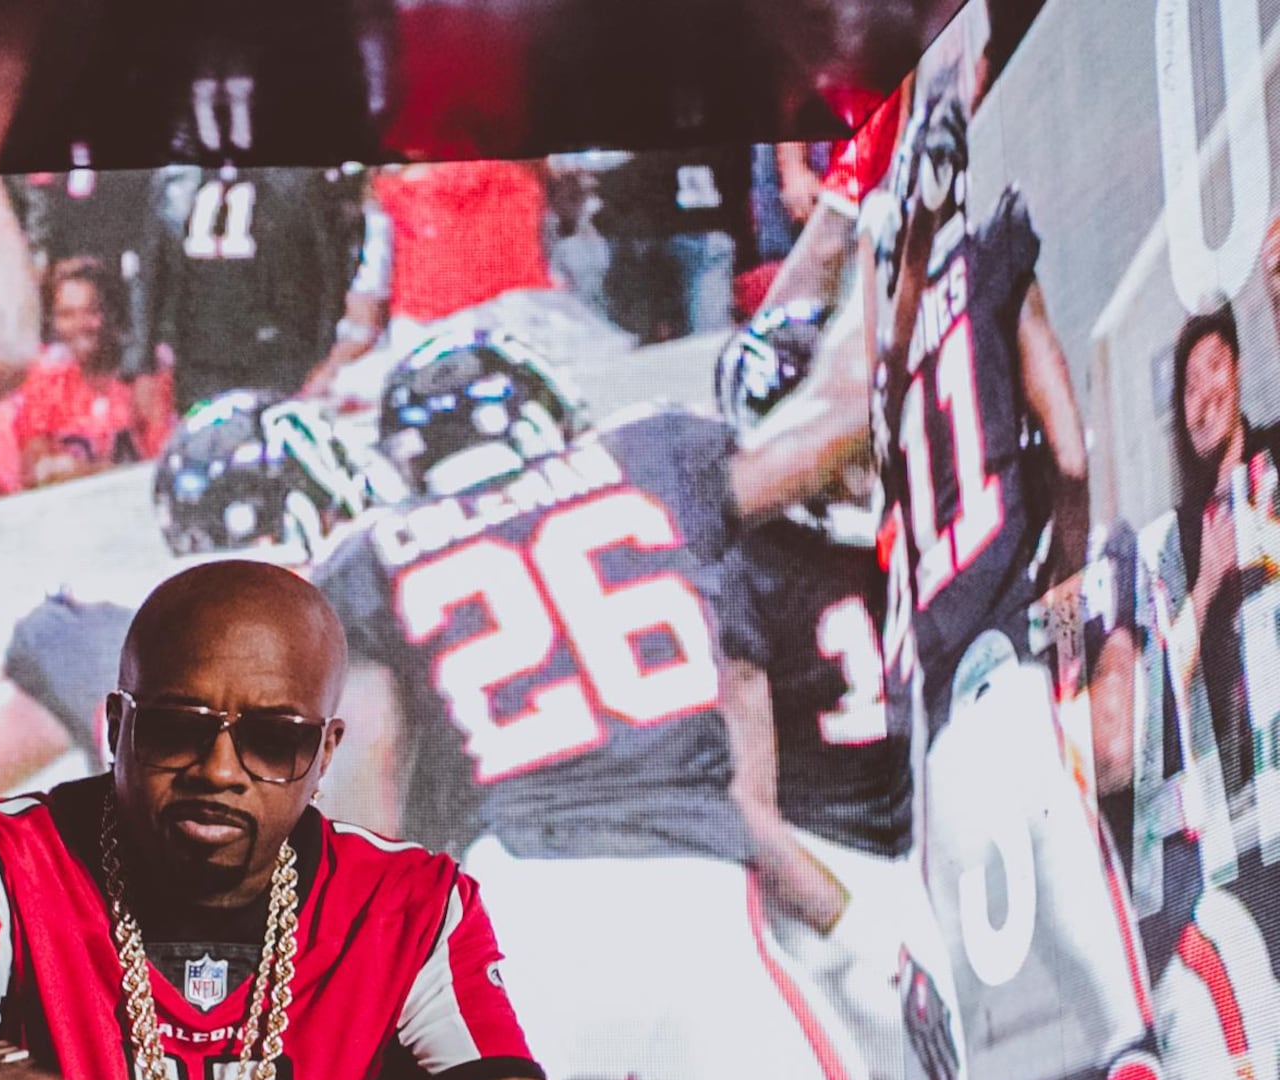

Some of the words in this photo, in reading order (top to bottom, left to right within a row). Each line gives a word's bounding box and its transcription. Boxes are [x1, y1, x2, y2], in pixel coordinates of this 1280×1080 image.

[184, 181, 256, 258] 11
[899, 312, 1004, 612] 11
[391, 484, 723, 784] 26
[191, 980, 220, 998] NFL
[157, 1022, 246, 1043] ALCON
